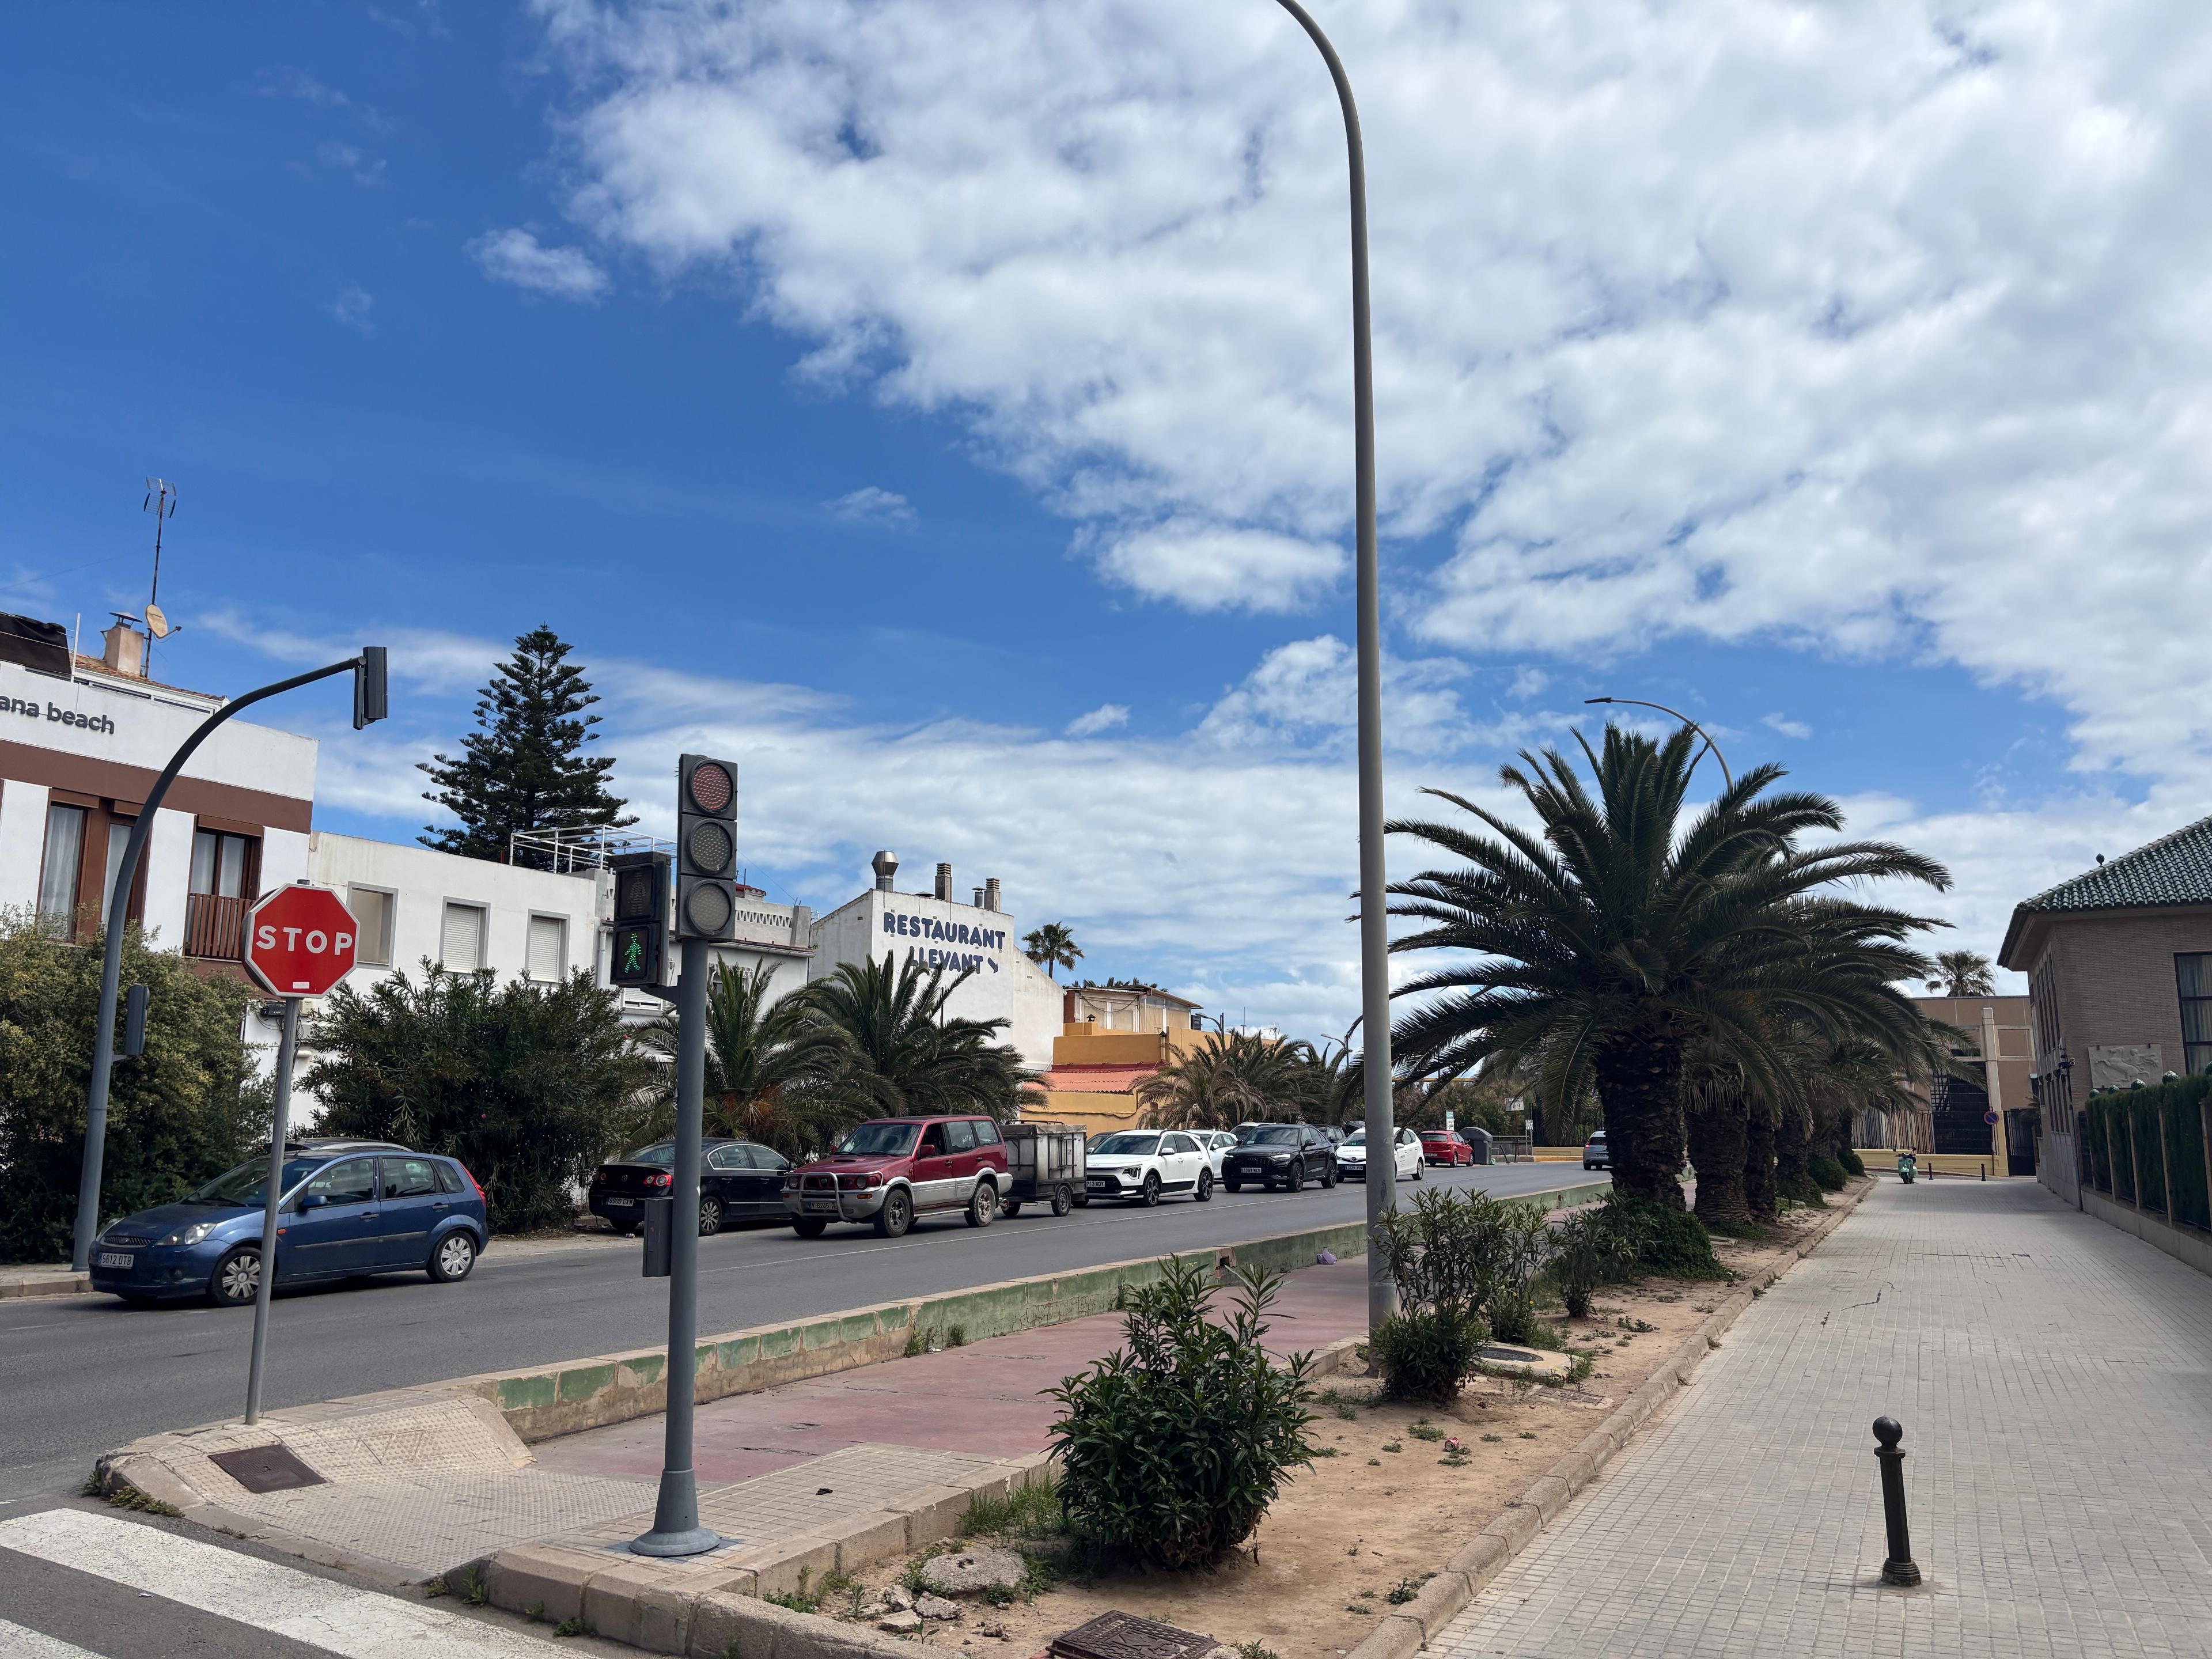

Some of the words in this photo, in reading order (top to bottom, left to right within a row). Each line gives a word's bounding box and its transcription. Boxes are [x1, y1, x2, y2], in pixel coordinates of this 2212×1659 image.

[47, 702, 115, 734] beach
[256, 925, 353, 956] STOP
[884, 912, 1006, 950] RESTAURANT
[103, 1254, 117, 1264] 5612
[119, 1256, 131, 1266] DTB
